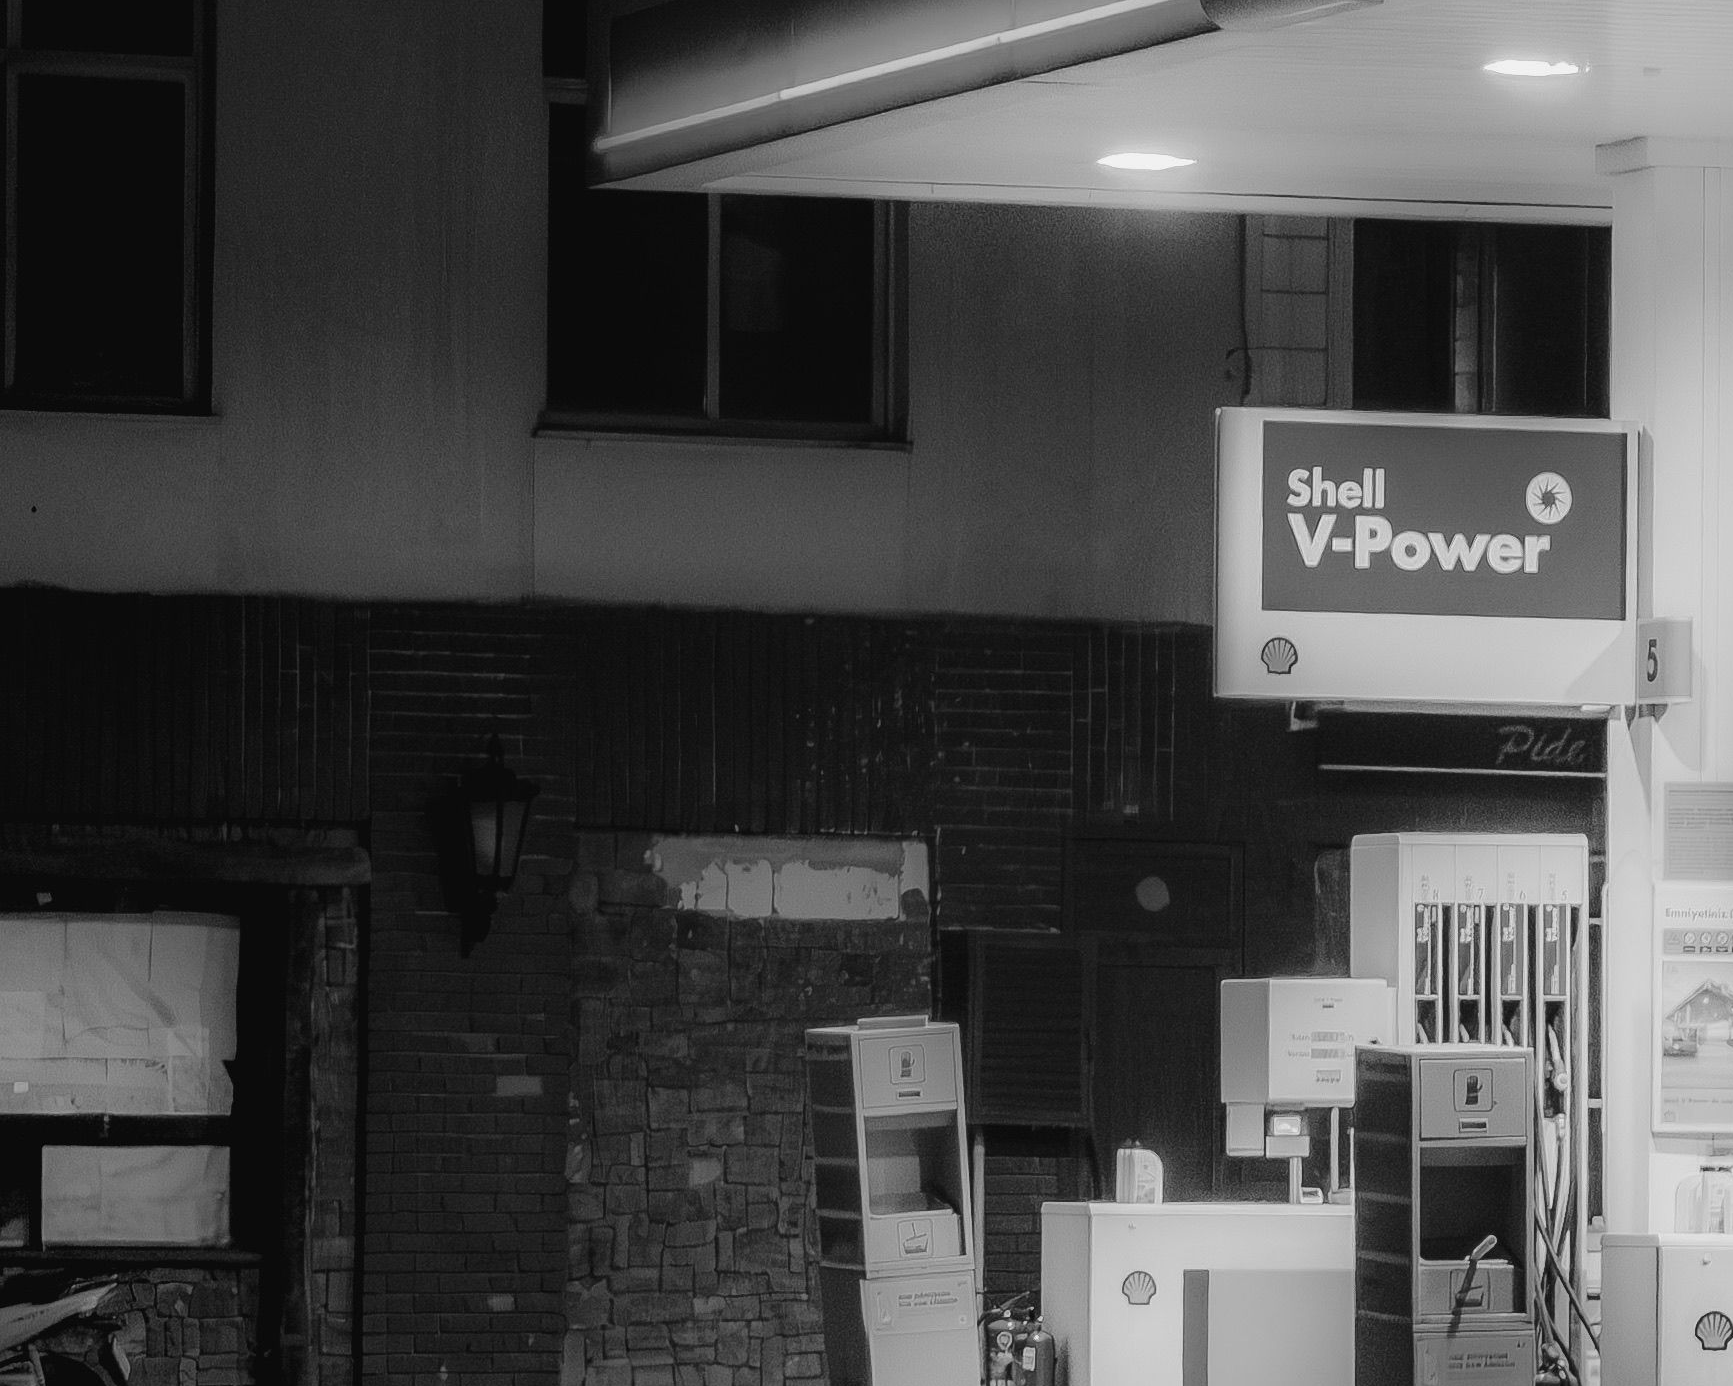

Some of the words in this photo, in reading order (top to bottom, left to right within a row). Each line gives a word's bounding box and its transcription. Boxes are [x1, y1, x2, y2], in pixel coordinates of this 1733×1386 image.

[1286, 466, 1387, 509] Shell
[1286, 512, 1552, 575] V-Power
[1645, 638, 1659, 683] 5
